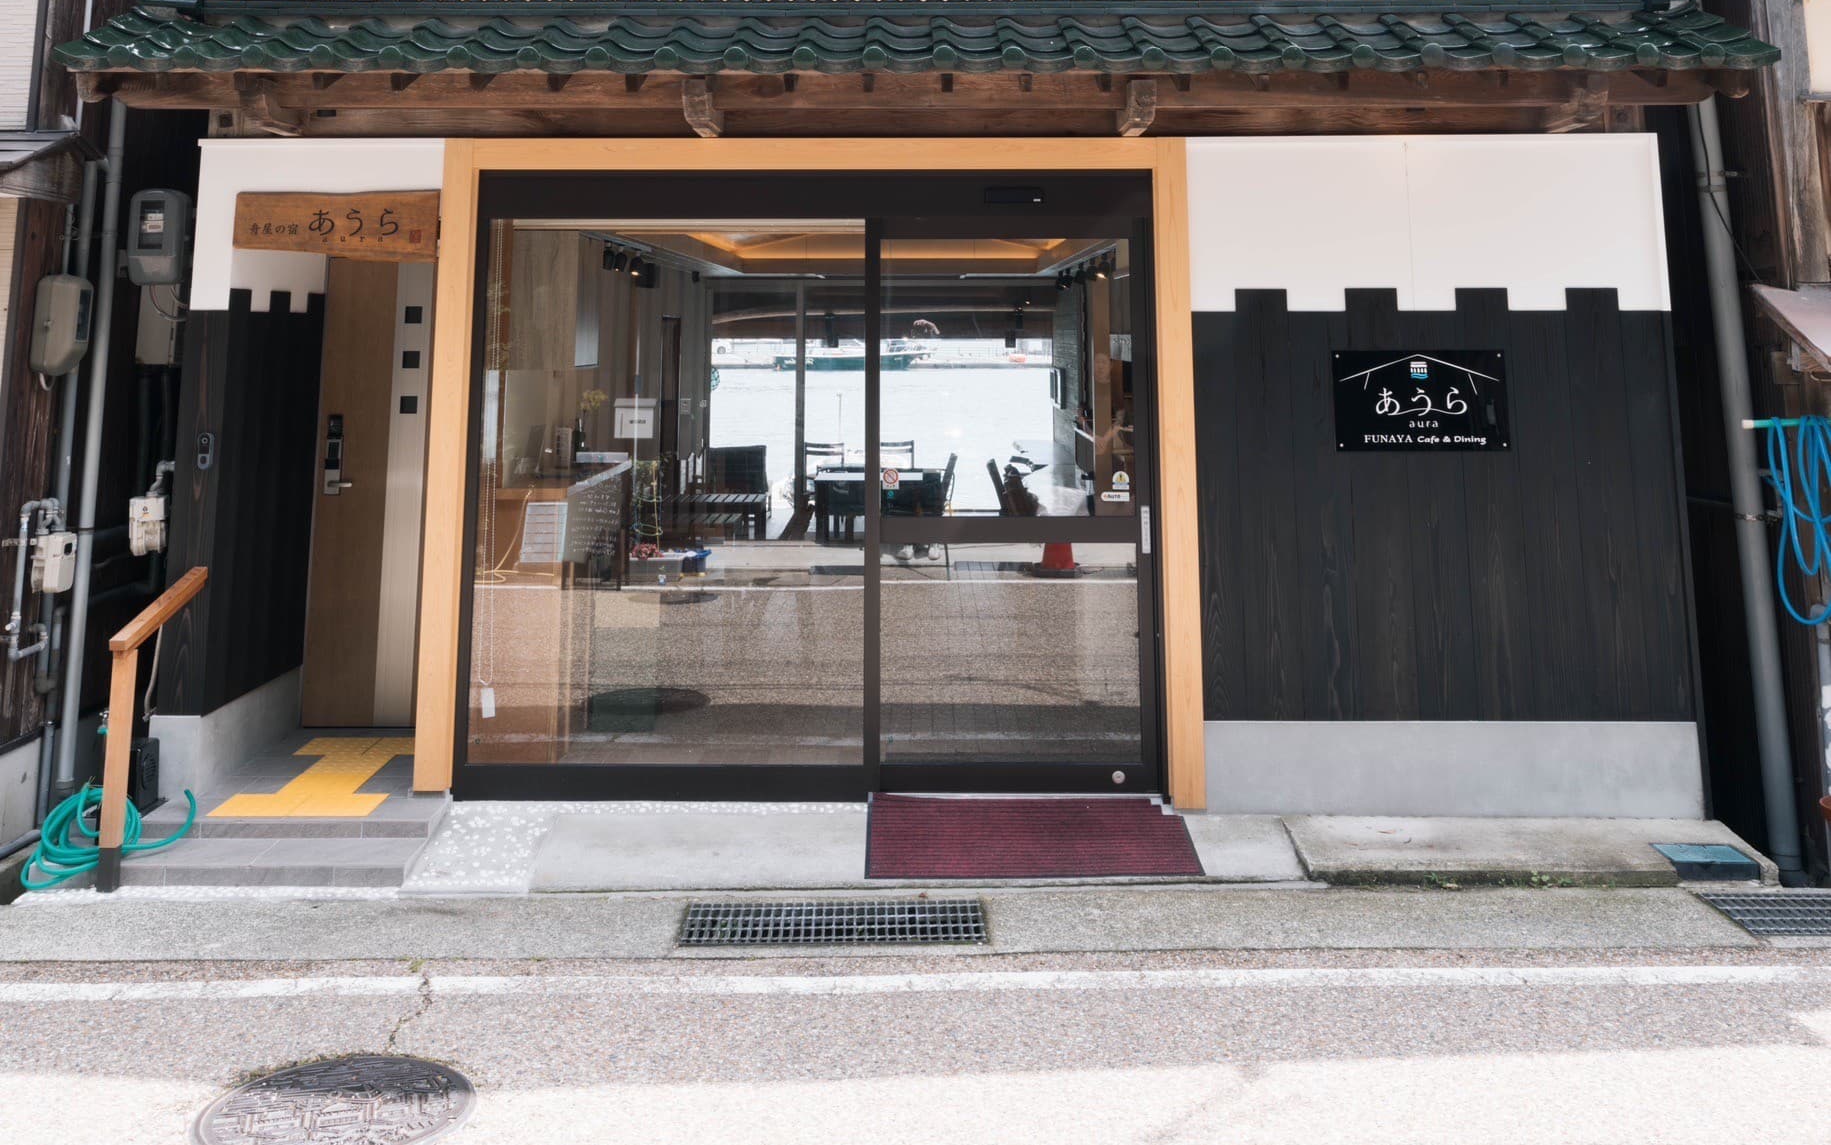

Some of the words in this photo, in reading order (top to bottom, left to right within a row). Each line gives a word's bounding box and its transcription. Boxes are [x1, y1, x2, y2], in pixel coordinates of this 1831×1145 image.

[308, 208, 399, 237] あうら
[1375, 386, 1468, 417] あうら
[1409, 419, 1439, 428] aura
[1364, 434, 1413, 443] FUNAYA
[1417, 435, 1440, 444] Cafe
[1442, 435, 1451, 443] &
[1454, 435, 1487, 445] Dining
